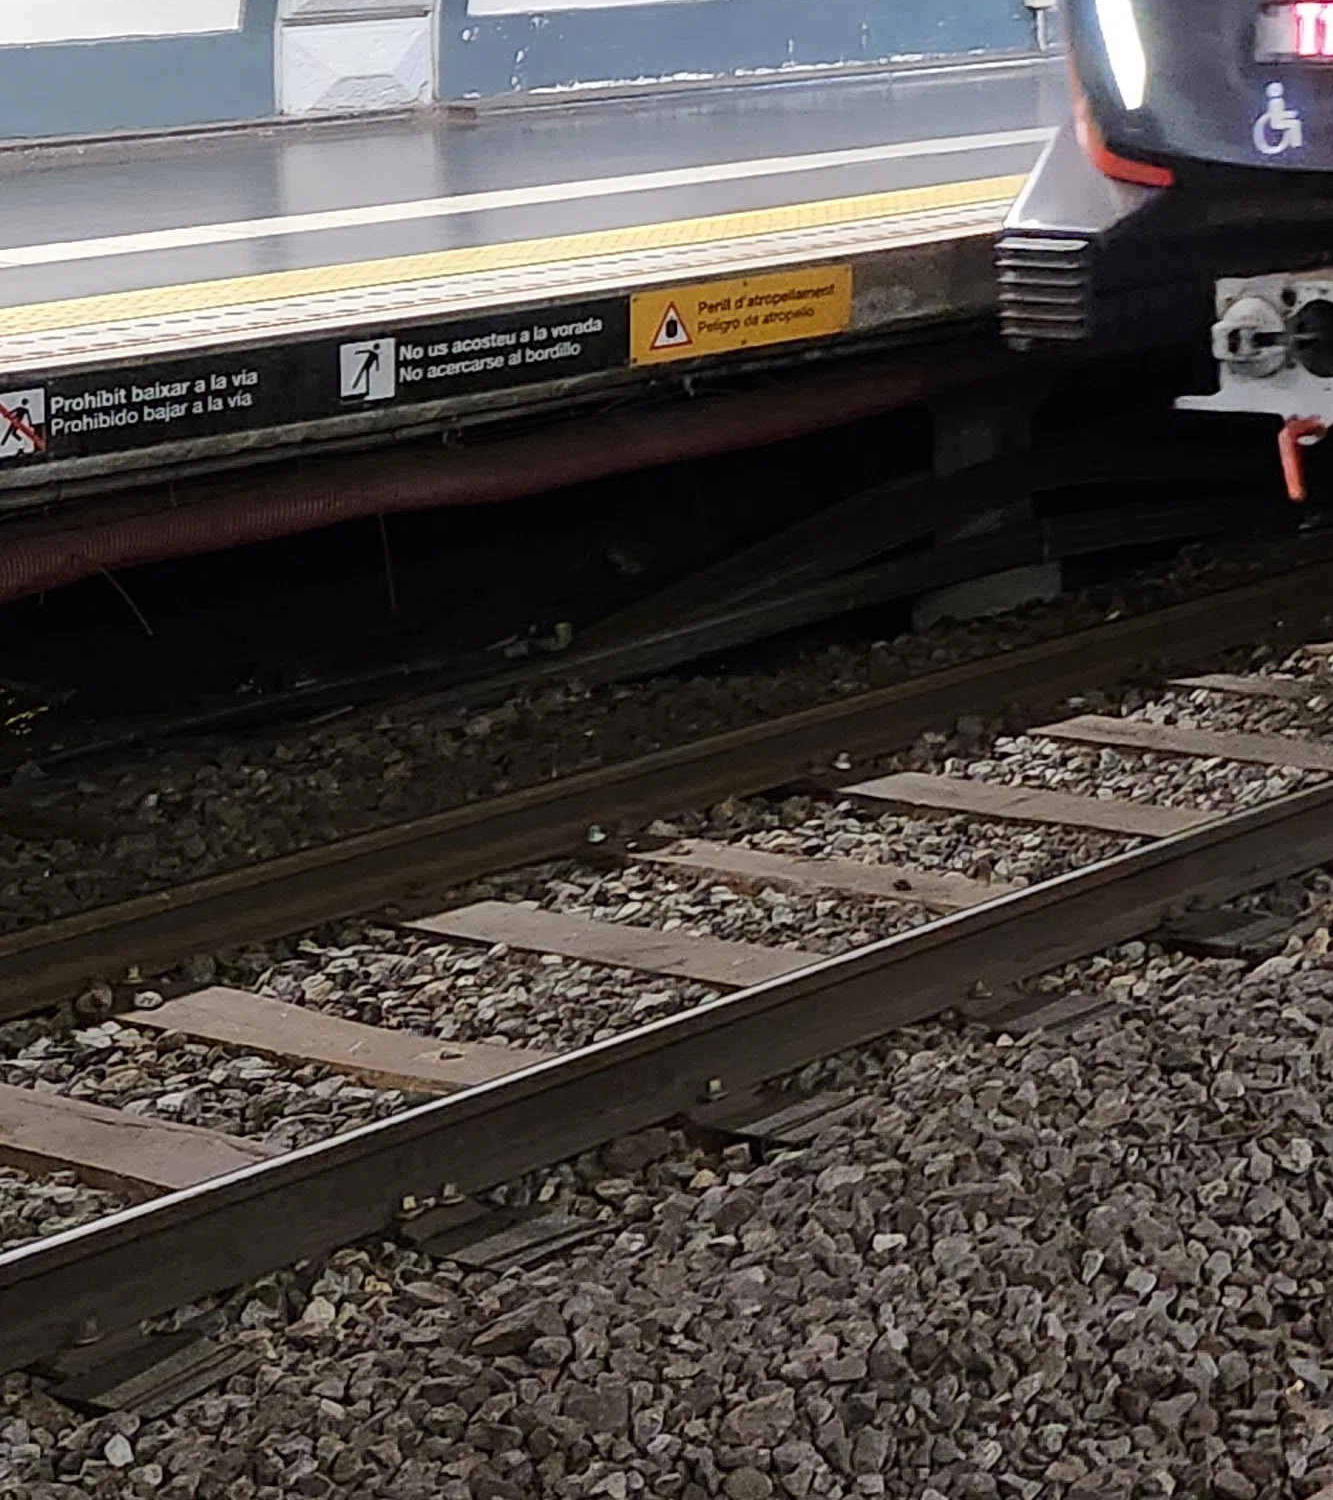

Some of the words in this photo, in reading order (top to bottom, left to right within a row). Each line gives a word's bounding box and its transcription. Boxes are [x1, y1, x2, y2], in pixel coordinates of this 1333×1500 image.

[399, 344, 424, 361] No
[428, 342, 449, 357] us
[452, 332, 516, 354] acosteu
[519, 330, 530, 343] a
[534, 325, 548, 341] la
[550, 317, 603, 337] vorada
[697, 318, 740, 334] Peligro
[744, 315, 759, 327] de
[398, 366, 424, 383] No
[427, 354, 505, 378] acercarse
[508, 350, 523, 366] al
[525, 342, 581, 363] bordillo
[50, 387, 127, 415] Prohibit
[131, 381, 191, 402] baixar
[194, 379, 206, 393] a
[209, 374, 227, 390] la
[51, 409, 139, 437] Prohibido
[143, 402, 190, 422] bajar
[191, 401, 203, 414] a
[207, 395, 224, 411] la
[227, 389, 254, 407] vía
